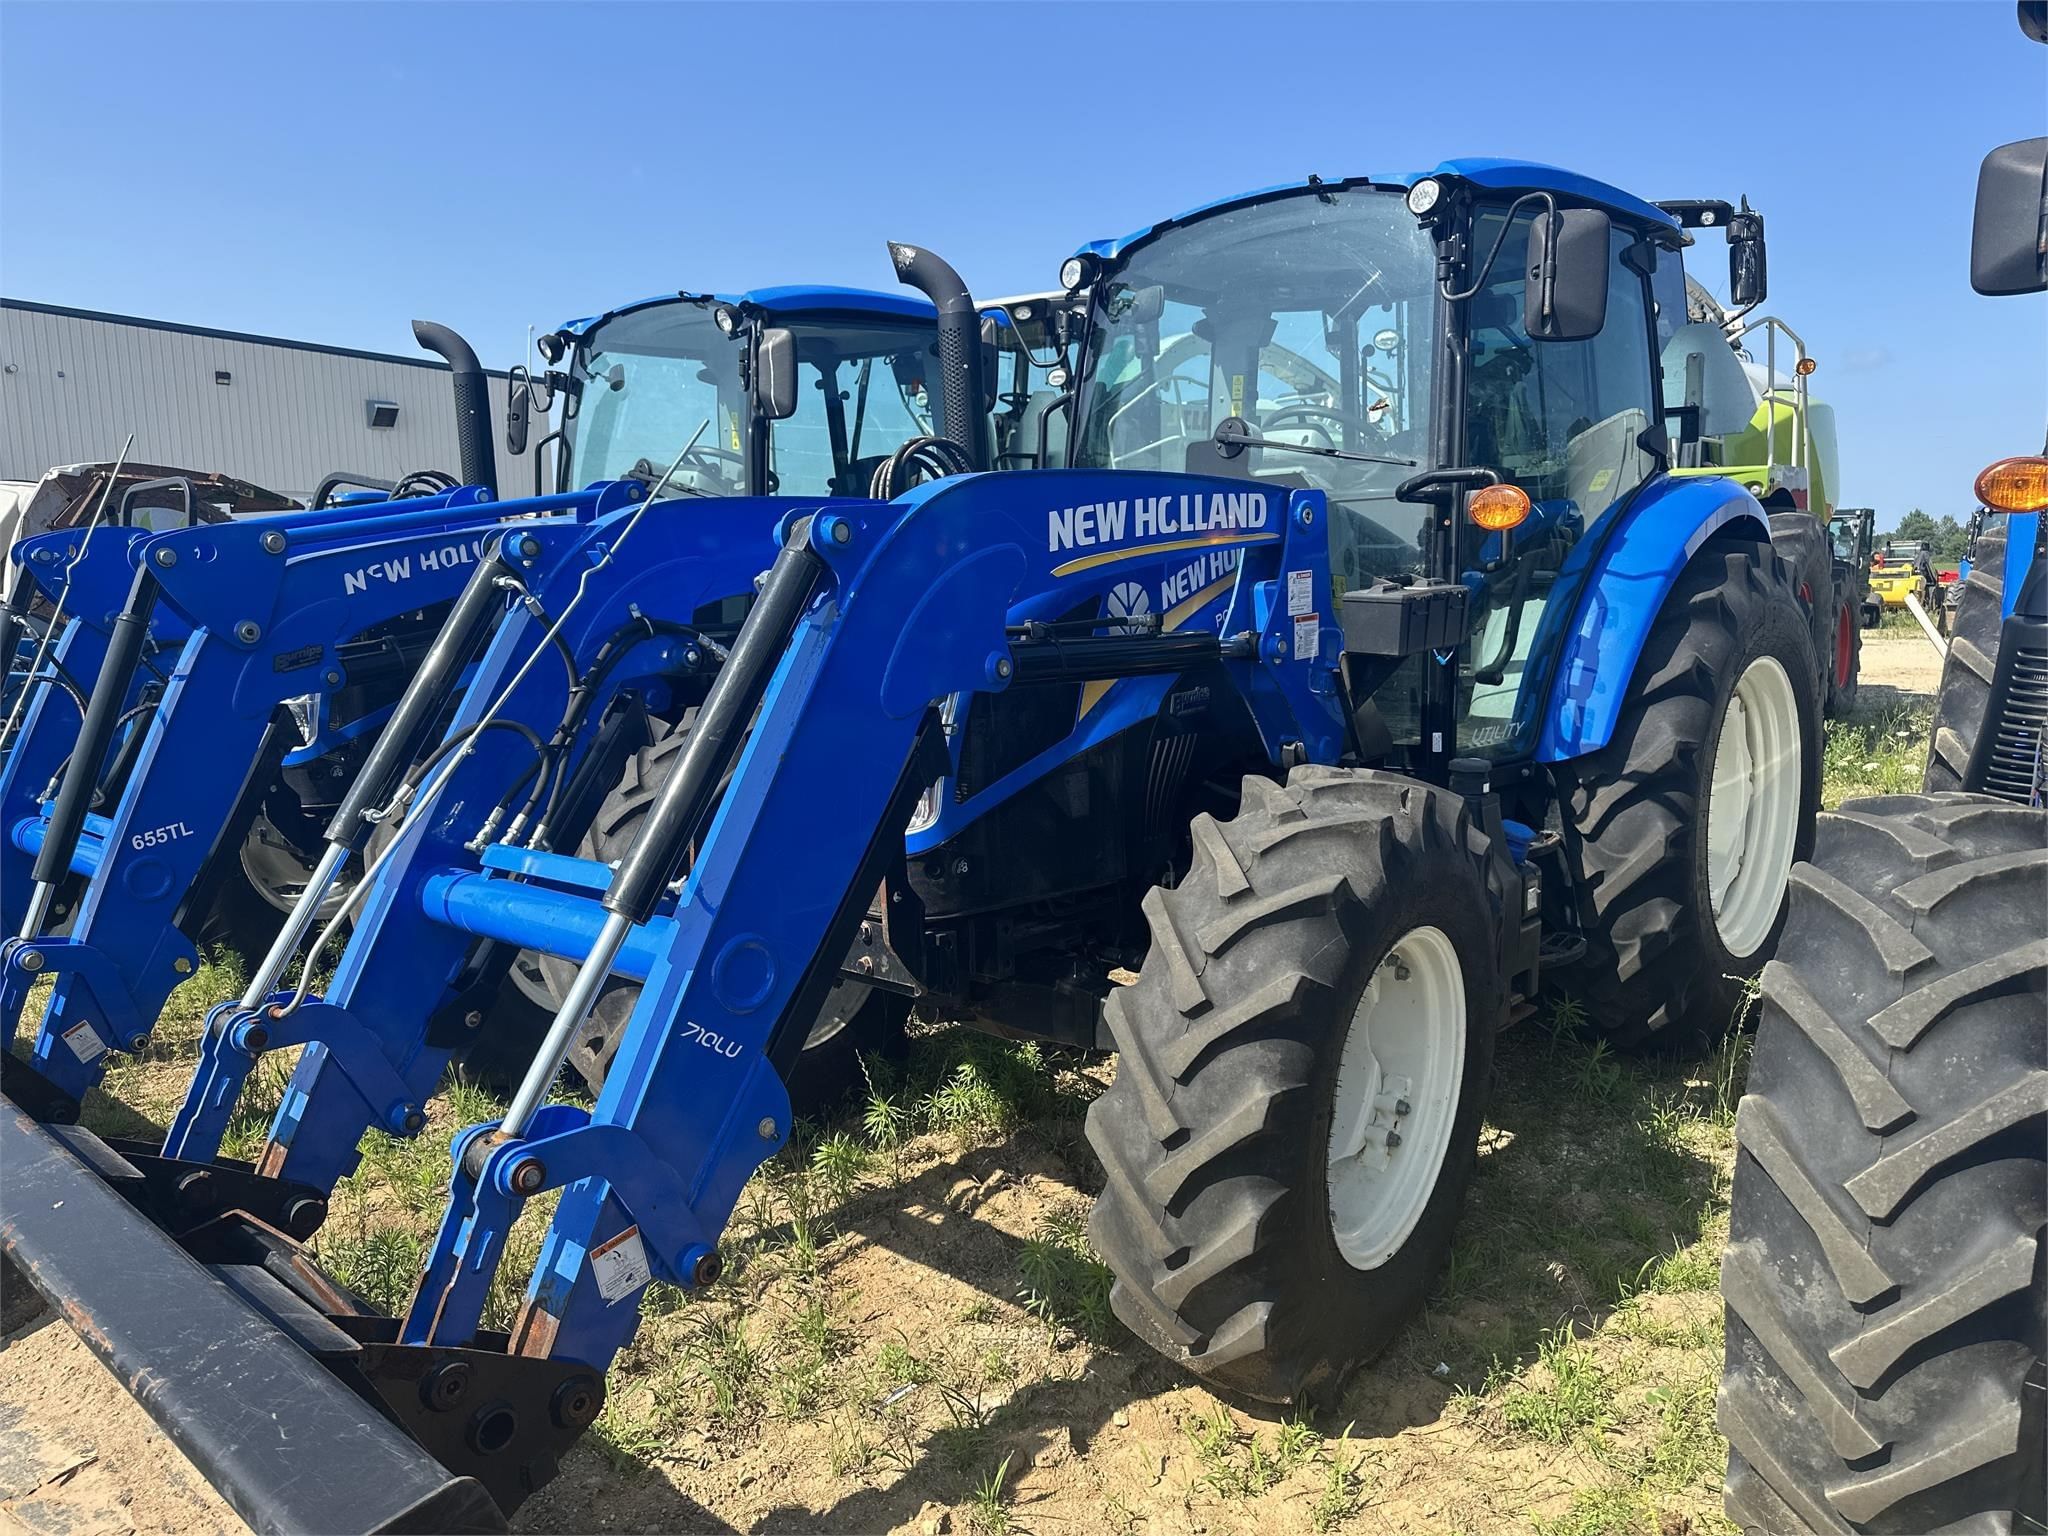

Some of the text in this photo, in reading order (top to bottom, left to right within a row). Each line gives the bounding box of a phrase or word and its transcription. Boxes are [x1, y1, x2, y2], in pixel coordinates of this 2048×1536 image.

[1049, 493, 1267, 552] NEW HOLLAND
[1161, 557, 1206, 611] NEW
[1472, 721, 1526, 743] UTILITY
[132, 822, 194, 850] 655TL
[680, 1021, 743, 1058] 710LU
